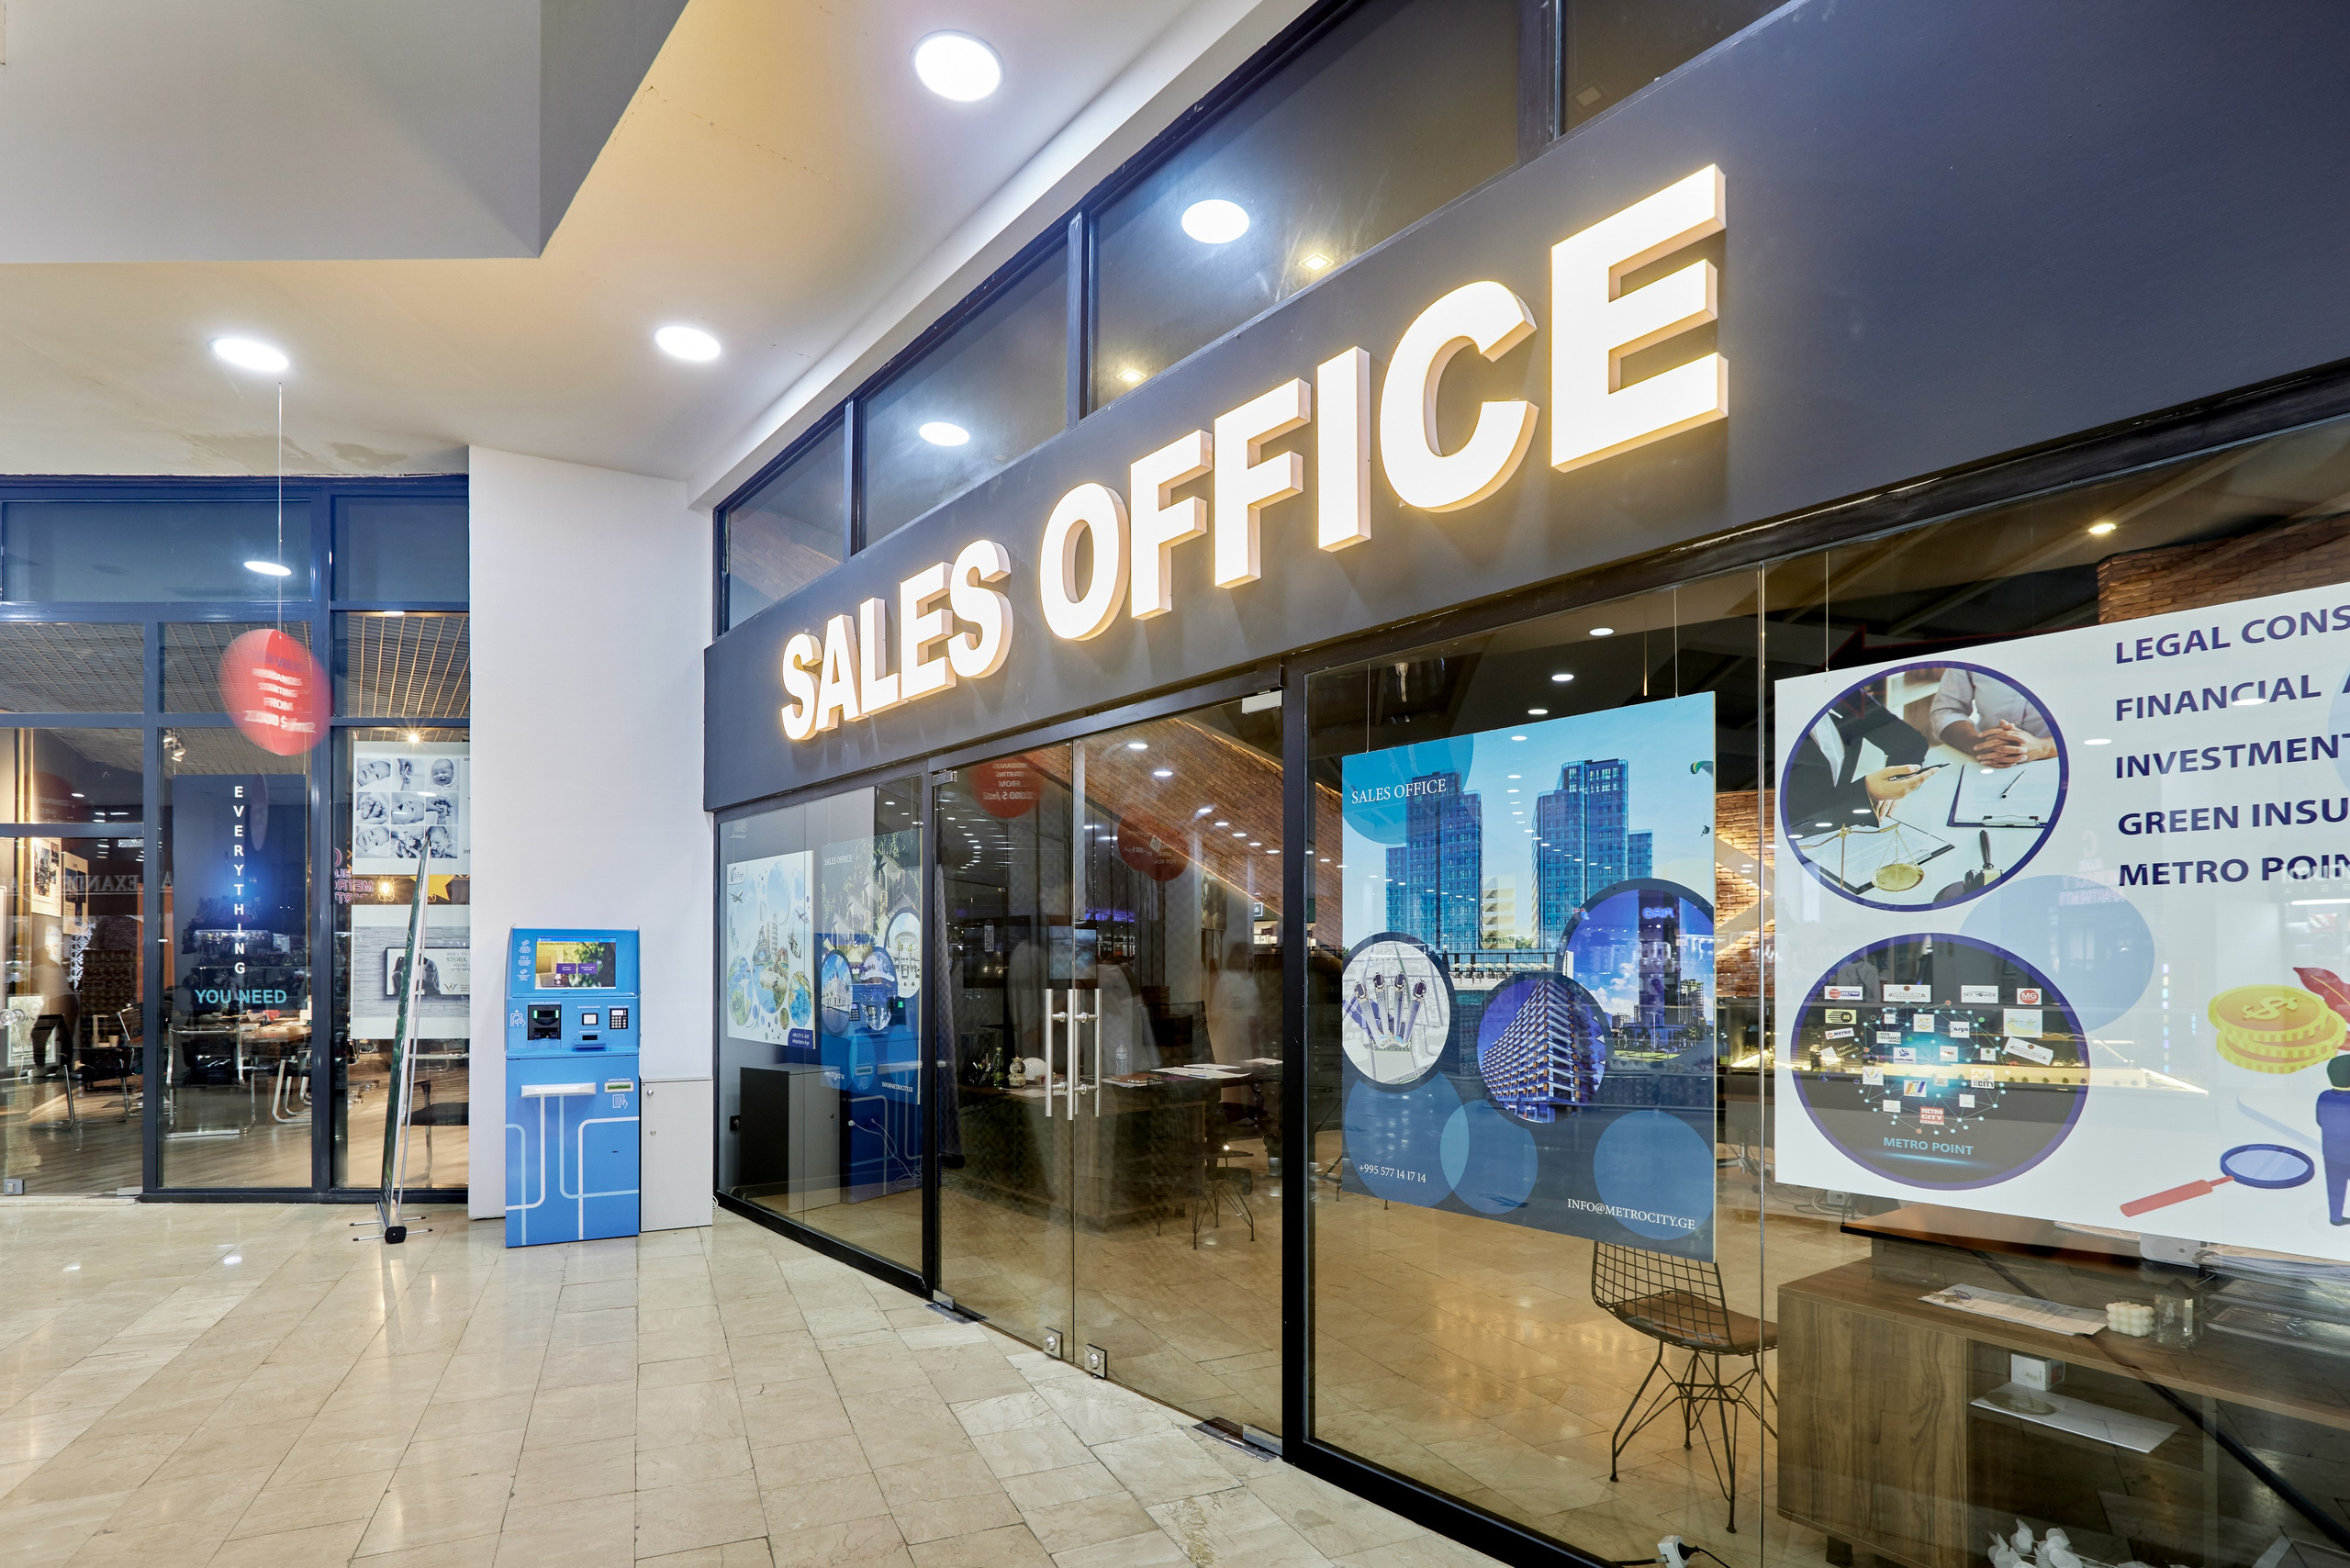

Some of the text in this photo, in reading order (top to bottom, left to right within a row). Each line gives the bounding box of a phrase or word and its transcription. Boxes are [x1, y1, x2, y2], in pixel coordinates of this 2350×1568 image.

[780, 162, 1729, 742] SALES OFFICE
[2116, 604, 2350, 665] LEGAL CONS
[263, 697, 294, 711] FROM
[2116, 674, 2322, 722] FINANCIAL
[1351, 778, 1447, 804] SALES OFFICE
[2118, 797, 2350, 835] GREEN INSU
[823, 854, 853, 866] SALES OFFICE
[2119, 858, 2249, 887] METRO
[233, 785, 246, 975] EVERYTHING
[195, 989, 287, 1005] YOU NEED
[1884, 1137, 1974, 1156] METRO POINT
[1359, 1163, 1427, 1183] +995 577 14 17 14
[1567, 1198, 1696, 1230] INFO@METROCITY.GE
